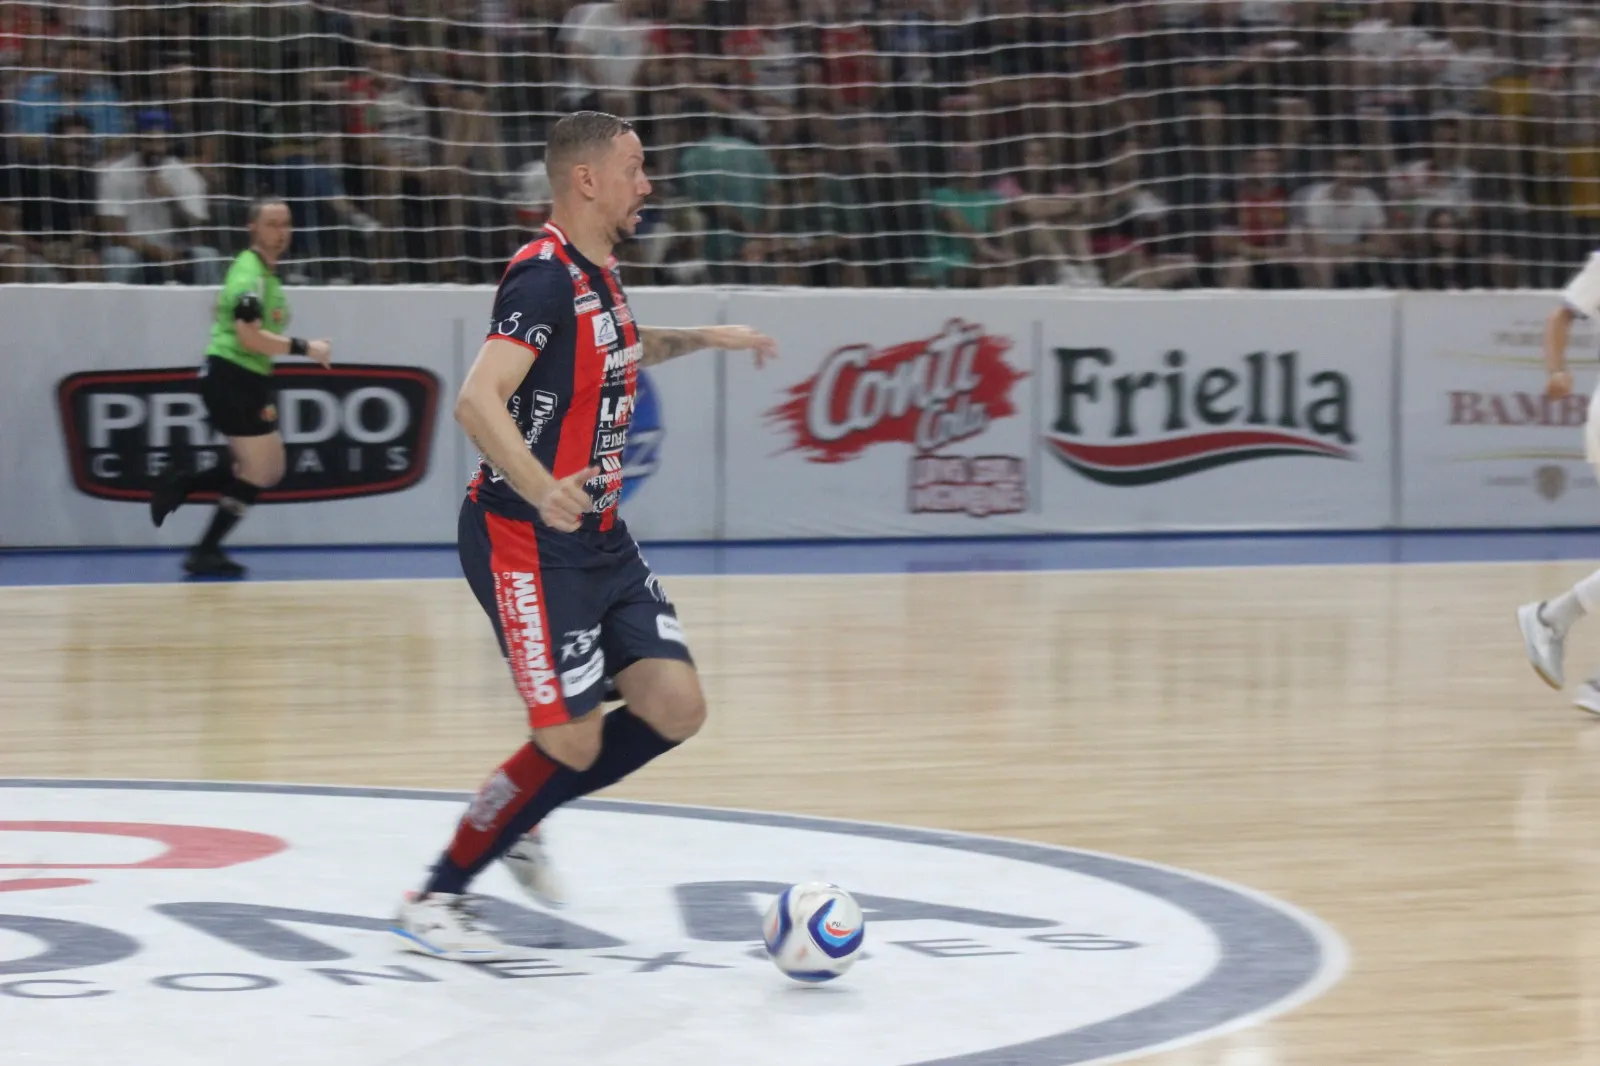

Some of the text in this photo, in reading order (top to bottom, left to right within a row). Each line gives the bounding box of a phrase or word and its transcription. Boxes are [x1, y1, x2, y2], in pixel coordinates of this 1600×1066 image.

[806, 318, 985, 444] Conti
[1052, 346, 1357, 445] Friella
[88, 386, 410, 448] PRDO
[91, 446, 410, 478] CERAIS
[1, 932, 1141, 999] CONEXES
